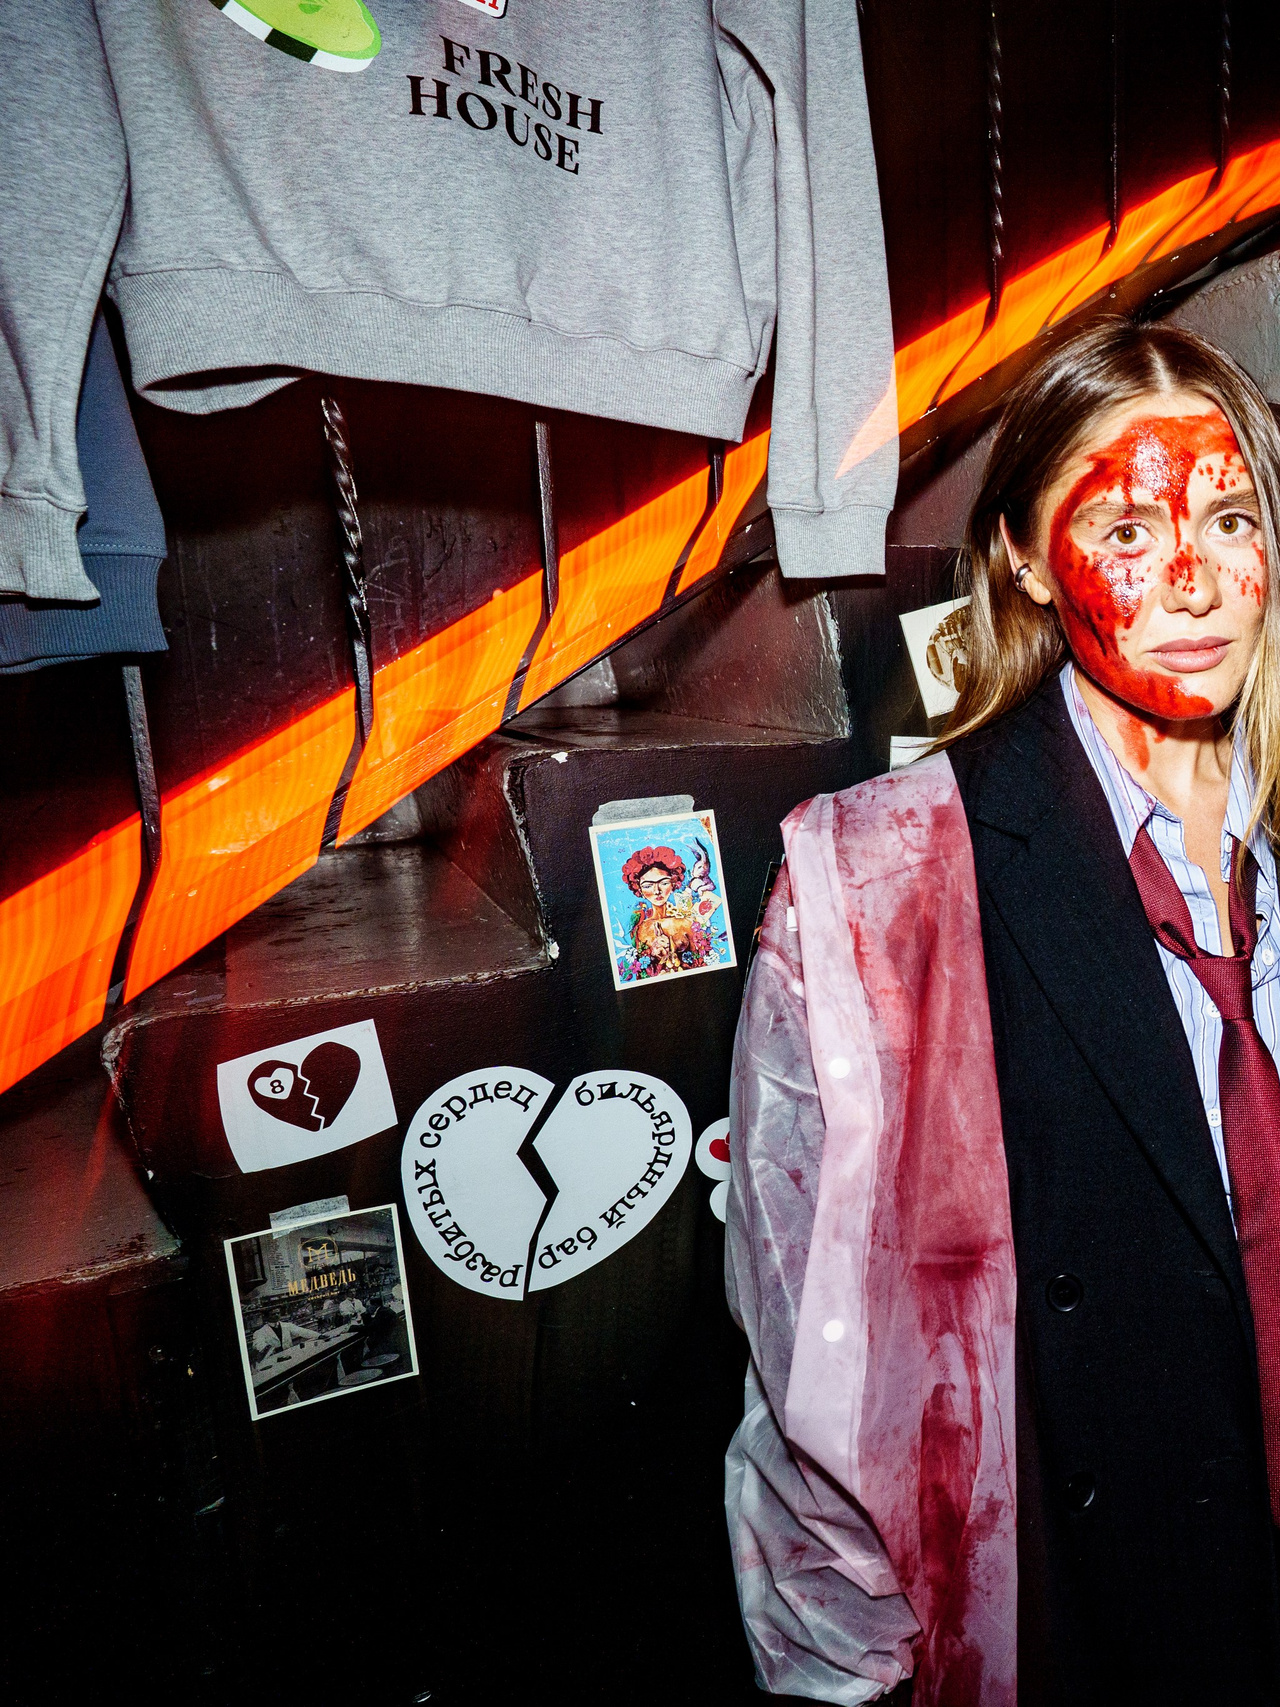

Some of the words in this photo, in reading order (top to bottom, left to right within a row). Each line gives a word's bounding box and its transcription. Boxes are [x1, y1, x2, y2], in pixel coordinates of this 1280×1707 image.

[405, 74, 580, 175] HOUSE
[438, 34, 604, 135] FRESH
[270, 1079, 285, 1094] 8
[419, 1080, 539, 1149] сердец
[575, 1080, 676, 1229] бильярдный
[414, 1158, 524, 1287] разбитых
[538, 1226, 599, 1269] бар
[287, 1268, 357, 1297] МЕДВЕДЬ
